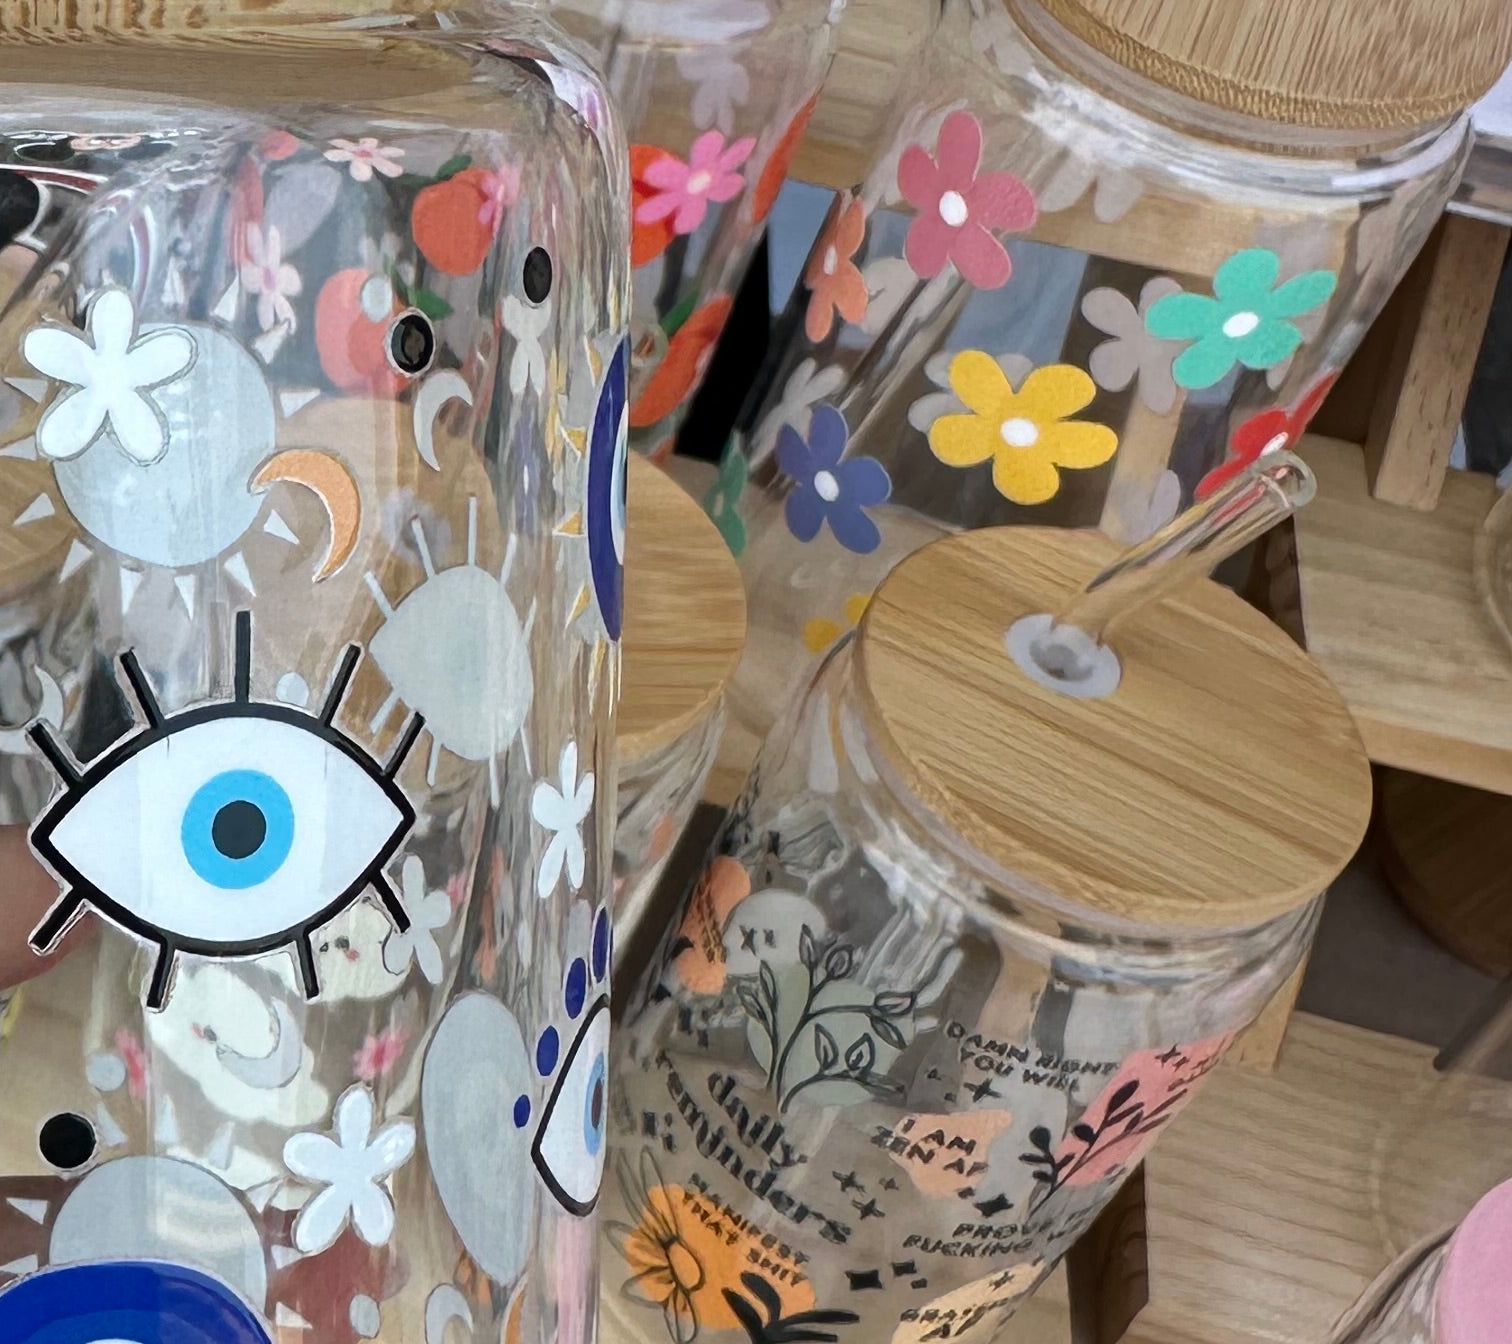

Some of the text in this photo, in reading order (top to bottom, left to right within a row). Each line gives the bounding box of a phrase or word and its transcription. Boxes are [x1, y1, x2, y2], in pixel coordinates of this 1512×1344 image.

[945, 1020, 1030, 1063] DAMN
[959, 1047, 1015, 1078] YOU
[707, 1071, 809, 1173] daily
[919, 1128, 978, 1156] AM
